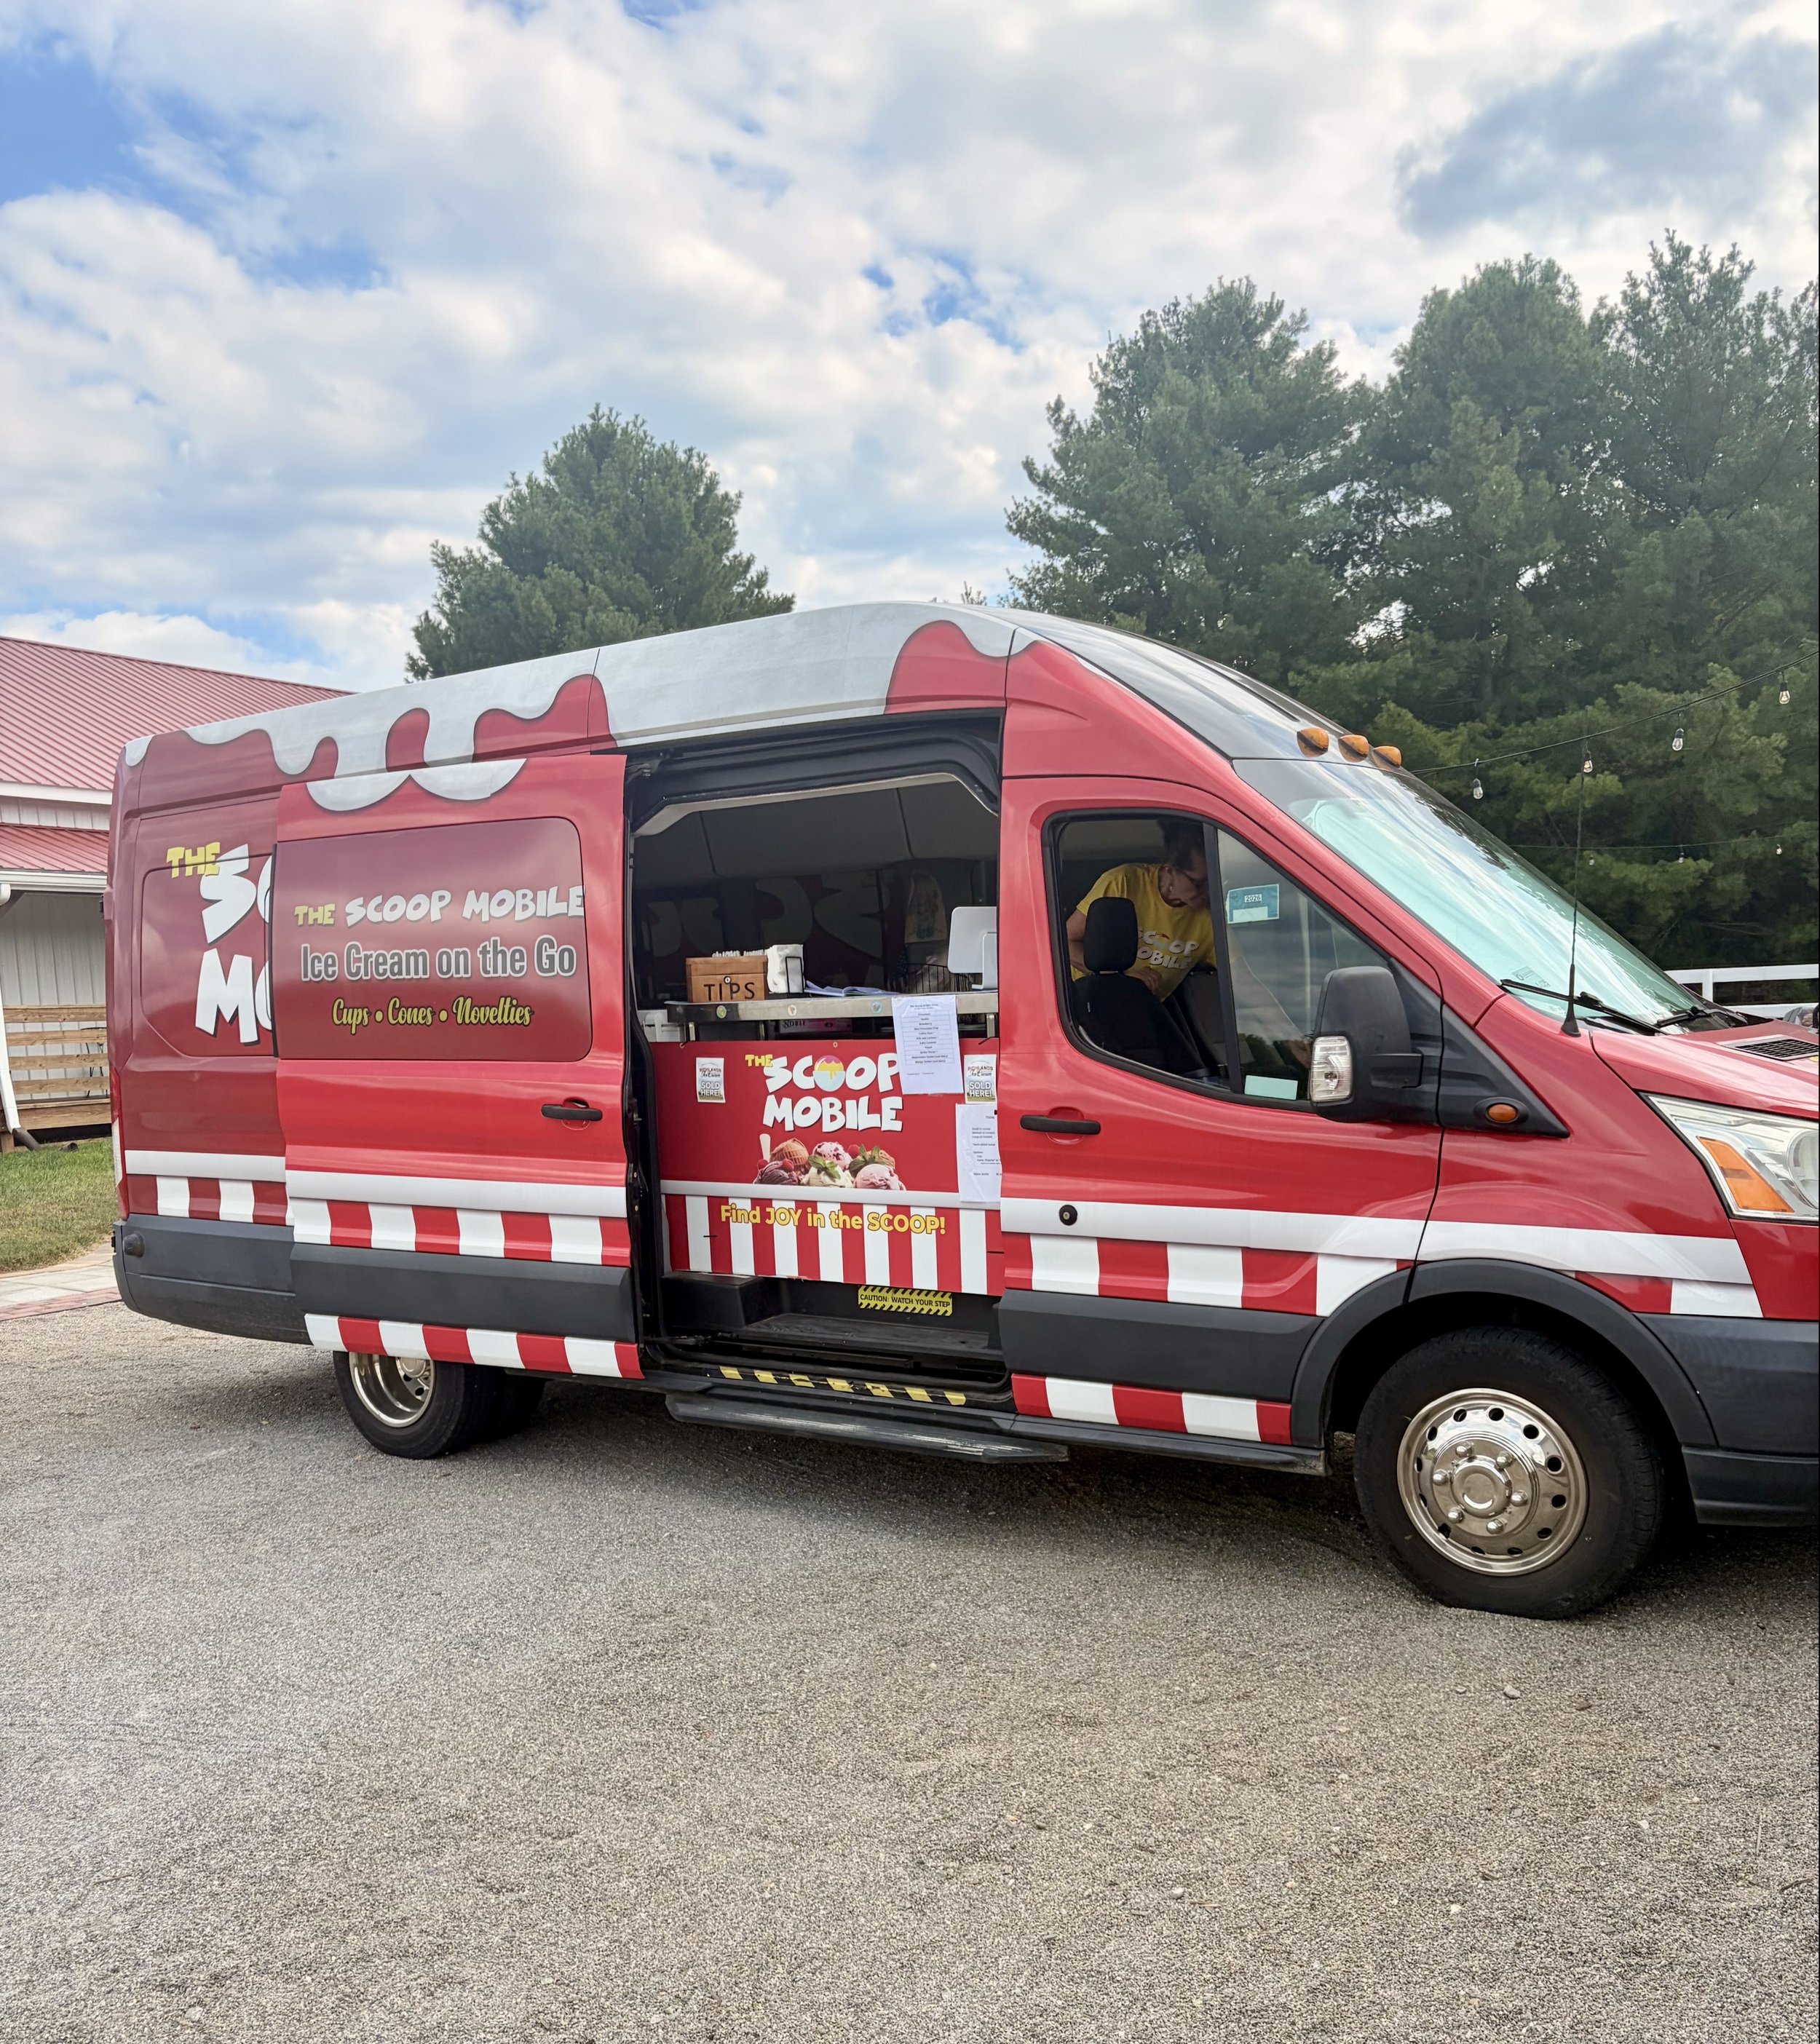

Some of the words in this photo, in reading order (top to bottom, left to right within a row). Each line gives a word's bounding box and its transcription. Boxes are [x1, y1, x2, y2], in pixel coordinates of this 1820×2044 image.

[166, 842, 221, 879] THE
[294, 903, 336, 927] THE
[345, 890, 452, 928] SCOOP
[462, 885, 585, 922] MOBILE
[301, 943, 338, 982] Ice
[344, 941, 430, 981] Cream
[436, 948, 472, 979] on
[478, 936, 526, 978] the
[534, 934, 577, 978] Go
[703, 982, 755, 1002] TIPS
[332, 997, 370, 1035] Cups
[387, 997, 436, 1026] Cones
[451, 995, 534, 1027] Novelties
[745, 1054, 773, 1068] THE
[763, 1053, 901, 1093] SCOOP
[701, 1082, 721, 1090] SOLD
[969, 1082, 992, 1090] SOLD
[969, 1090, 992, 1098] HERE!
[762, 1094, 903, 1133] MOBILE
[720, 1203, 761, 1224] Find
[765, 1207, 802, 1227] JOY
[807, 1207, 826, 1228] in
[829, 1210, 863, 1230] the
[867, 1211, 946, 1235] SCOOP!
[860, 1294, 890, 1302] CAUTION:
[891, 1296, 914, 1305] WATCH
[915, 1299, 934, 1307] YOUR
[935, 1300, 951, 1308] STEP
